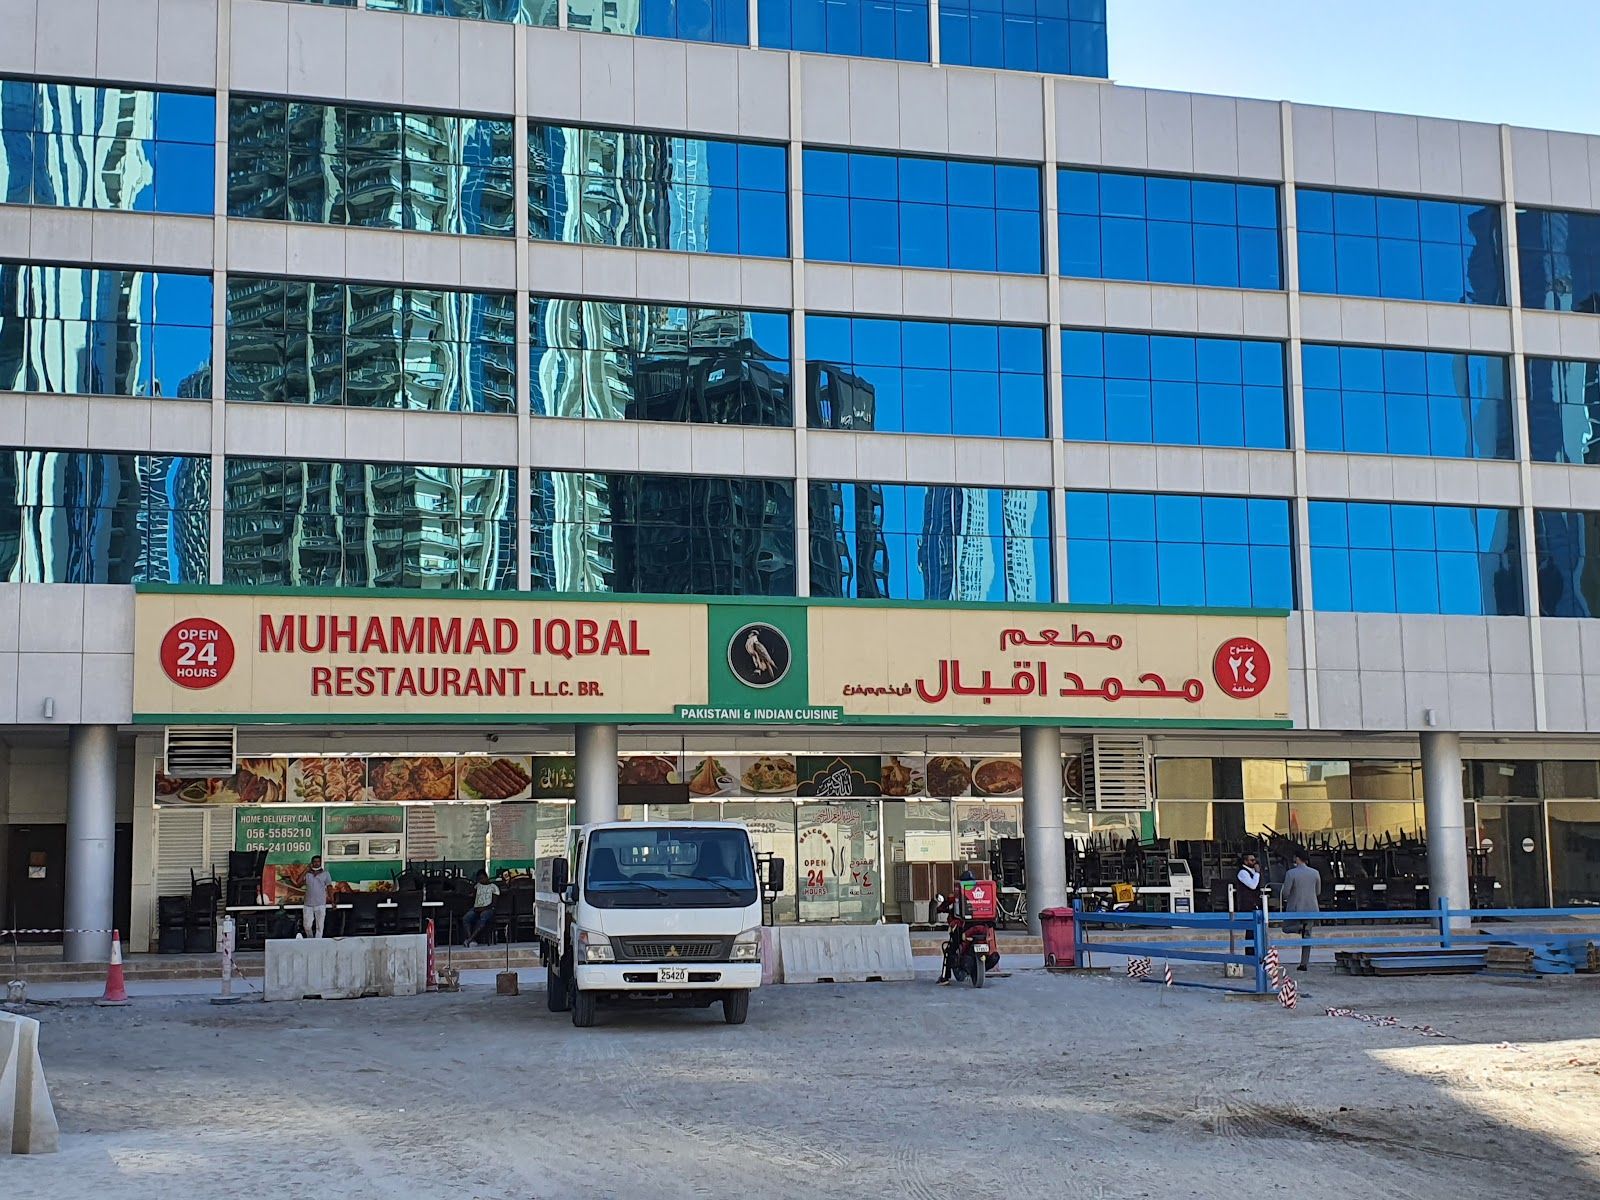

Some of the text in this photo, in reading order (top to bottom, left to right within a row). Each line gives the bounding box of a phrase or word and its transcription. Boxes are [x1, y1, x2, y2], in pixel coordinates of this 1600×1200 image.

[177, 629, 218, 641] OPEN
[259, 614, 650, 660] MUHAMMAD IQBAL
[1000, 624, 1123, 651] مطعم
[177, 642, 218, 666] 24
[1229, 644, 1255, 655] مفتوح
[176, 668, 218, 678] HOURS
[1228, 655, 1257, 683] ٢٤
[311, 666, 526, 697] RESTAURANT
[578, 681, 604, 697] BR.
[1059, 671, 1204, 703] محمد
[1231, 682, 1255, 692] ساعة
[681, 708, 839, 720] PAKISTANI & INDIAN CUISINE
[240, 814, 316, 823] HOME DELIVERY CALL
[246, 828, 312, 839] 056-5585210
[799, 828, 831, 844] WELCOME
[246, 842, 311, 853] 056-2410960
[804, 859, 826, 867] OPEN
[849, 859, 874, 869] مفتوح
[807, 869, 824, 887] 24
[852, 871, 873, 888] ٢٤
[661, 971, 685, 980] 25420
